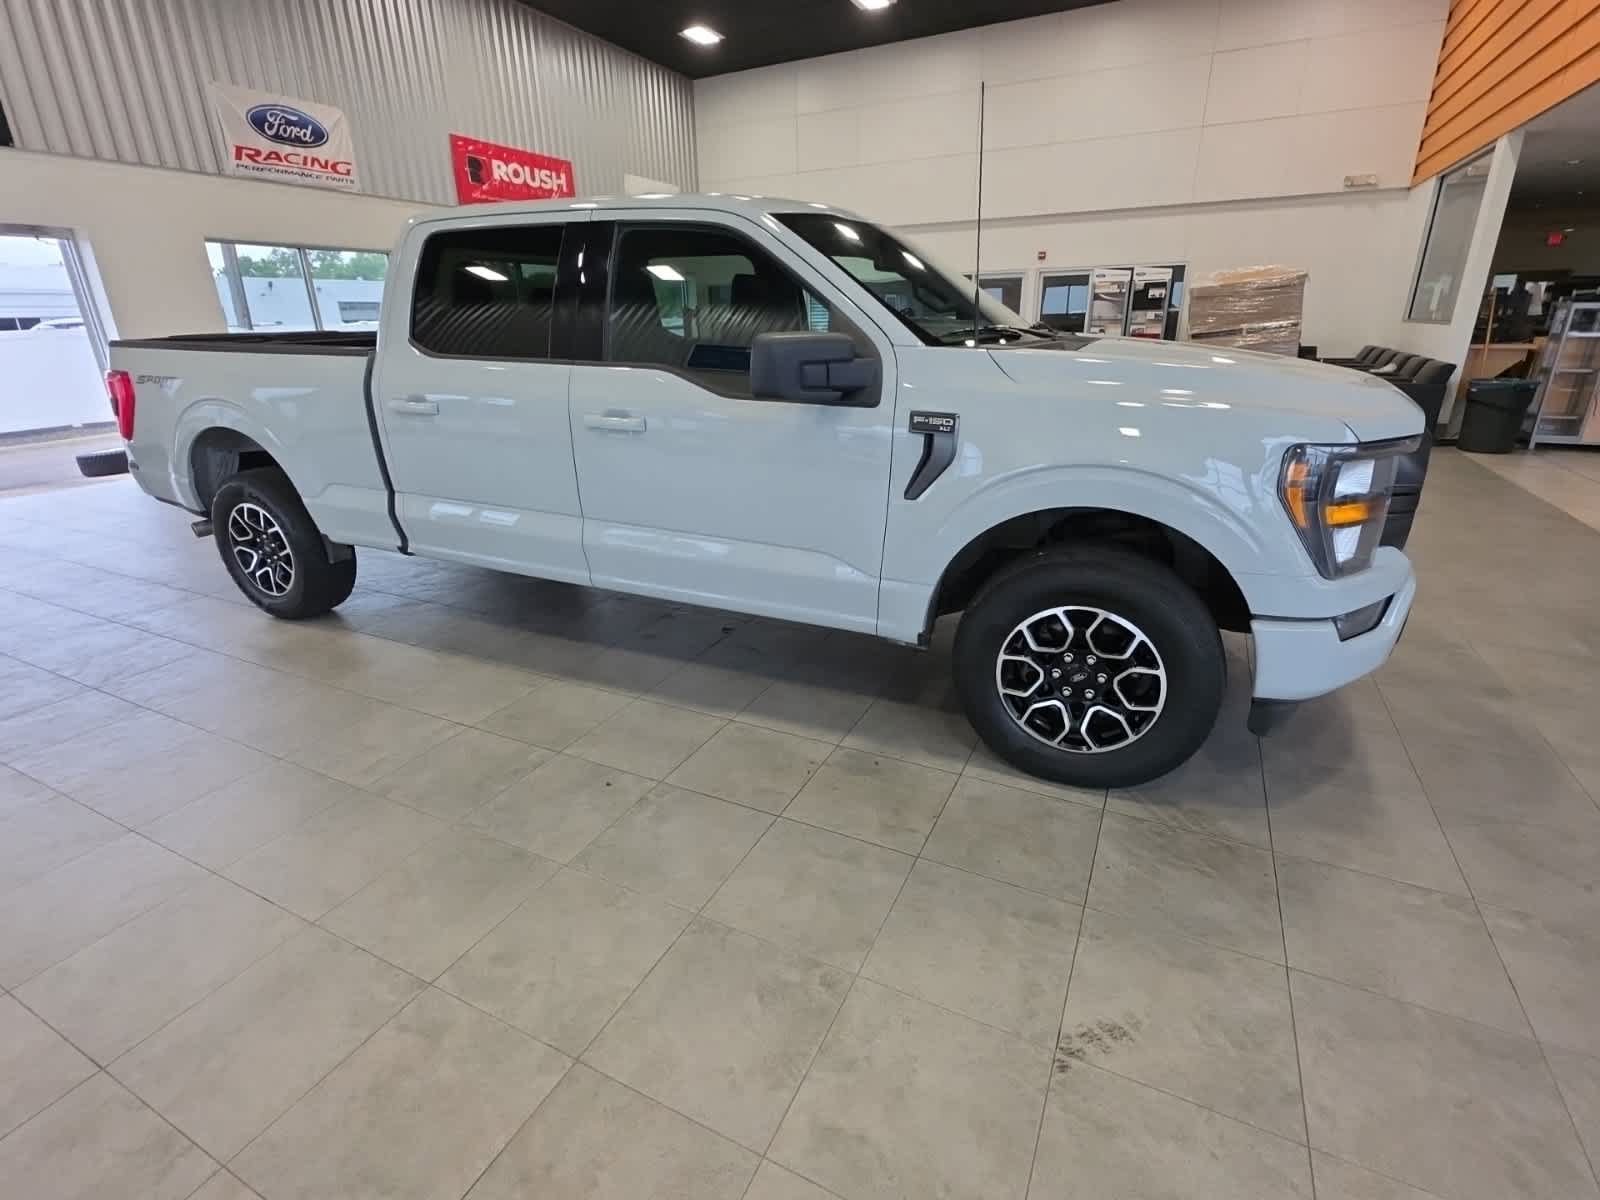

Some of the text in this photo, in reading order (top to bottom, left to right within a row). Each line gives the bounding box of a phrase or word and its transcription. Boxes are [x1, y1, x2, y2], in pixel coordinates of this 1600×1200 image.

[265, 110, 315, 142] Ford
[235, 145, 352, 176] RACING
[236, 163, 355, 185] PERFORMANCE PARTS
[491, 159, 568, 193] ROUSH
[913, 416, 954, 426] F-150
